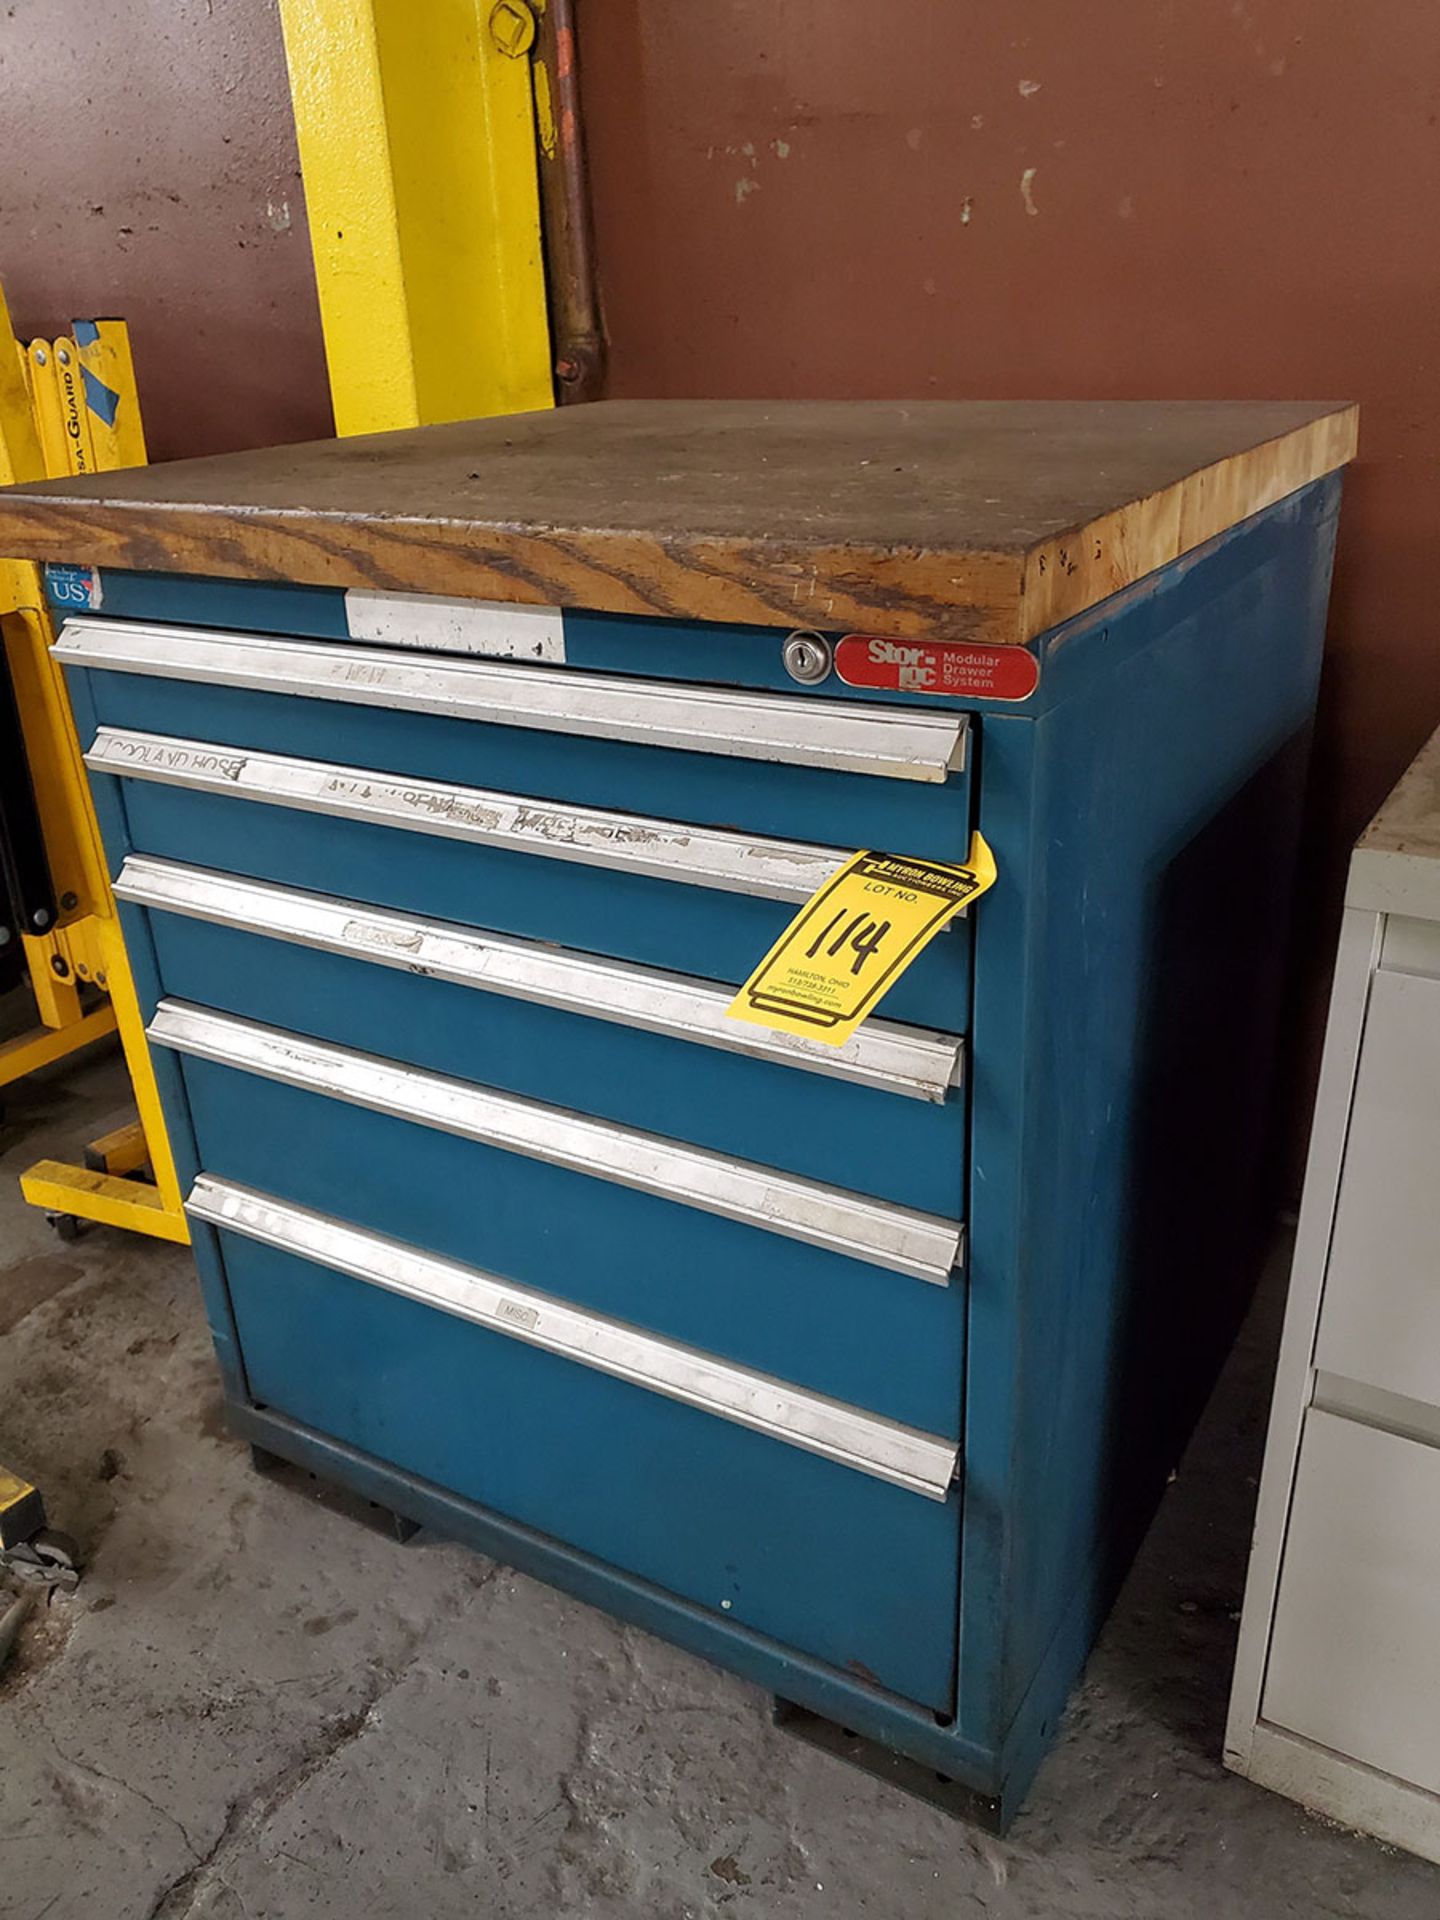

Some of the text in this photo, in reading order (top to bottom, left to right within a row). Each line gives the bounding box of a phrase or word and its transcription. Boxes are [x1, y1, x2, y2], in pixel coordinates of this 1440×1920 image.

[63, 372, 86, 473] SA-GUARD
[51, 582, 92, 602] US
[943, 652, 1000, 666] Modular
[943, 664, 993, 676] Drawer
[943, 675, 994, 688] System
[886, 860, 974, 894] MYRON BOWLING
[863, 881, 919, 904] LOT NO.
[805, 908, 892, 976] 114
